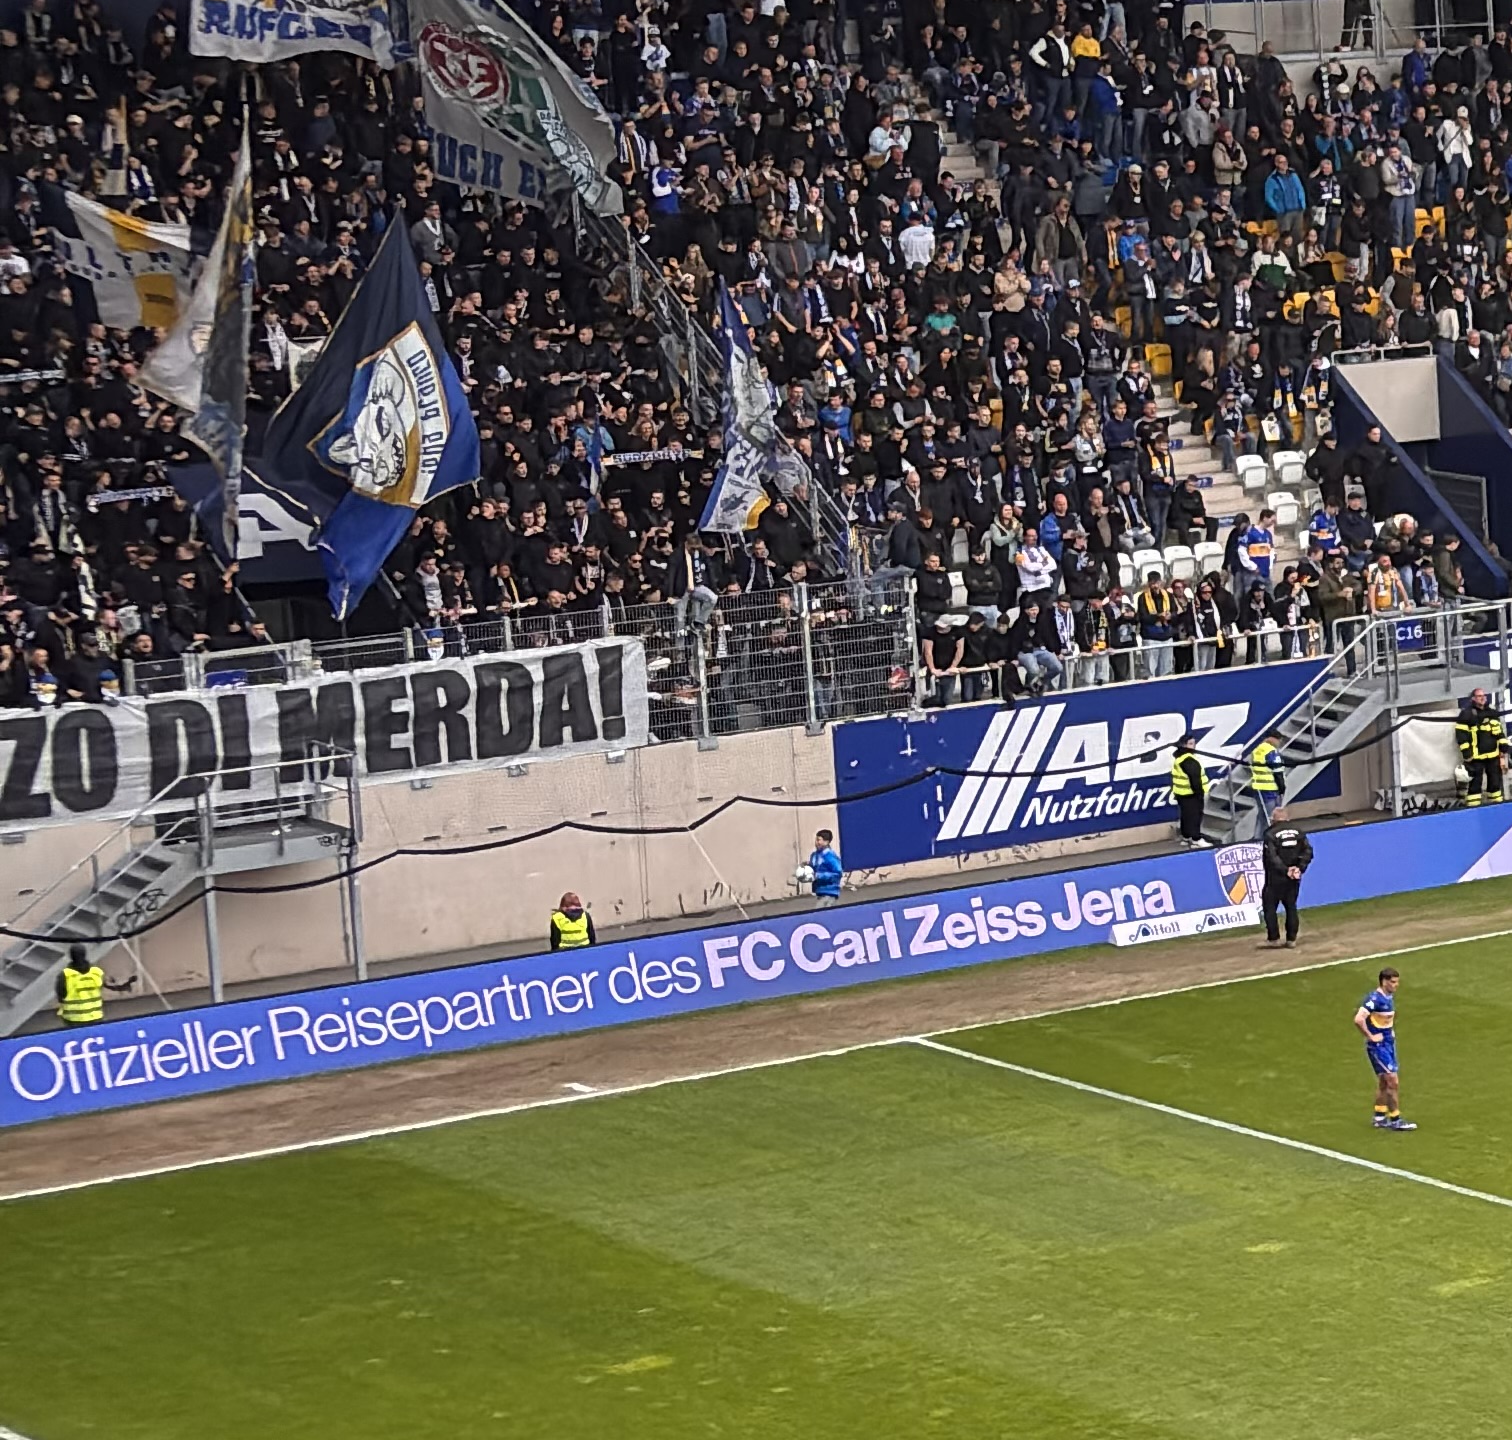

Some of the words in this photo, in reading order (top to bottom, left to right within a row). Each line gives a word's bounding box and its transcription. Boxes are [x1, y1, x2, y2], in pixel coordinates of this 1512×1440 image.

[1396, 624, 1423, 641] C16
[149, 692, 251, 801] DI
[278, 643, 626, 785] MERDA!
[1037, 701, 1252, 792] ABZ
[1219, 910, 1247, 924] Holl
[7, 1002, 260, 1103] Offizieller
[266, 962, 599, 1068] Reisepartner
[607, 947, 701, 1009] des
[705, 930, 786, 989] FC
[789, 909, 898, 974] Carl
[901, 894, 1048, 956] Zeiss
[1051, 878, 1176, 929] Jena
